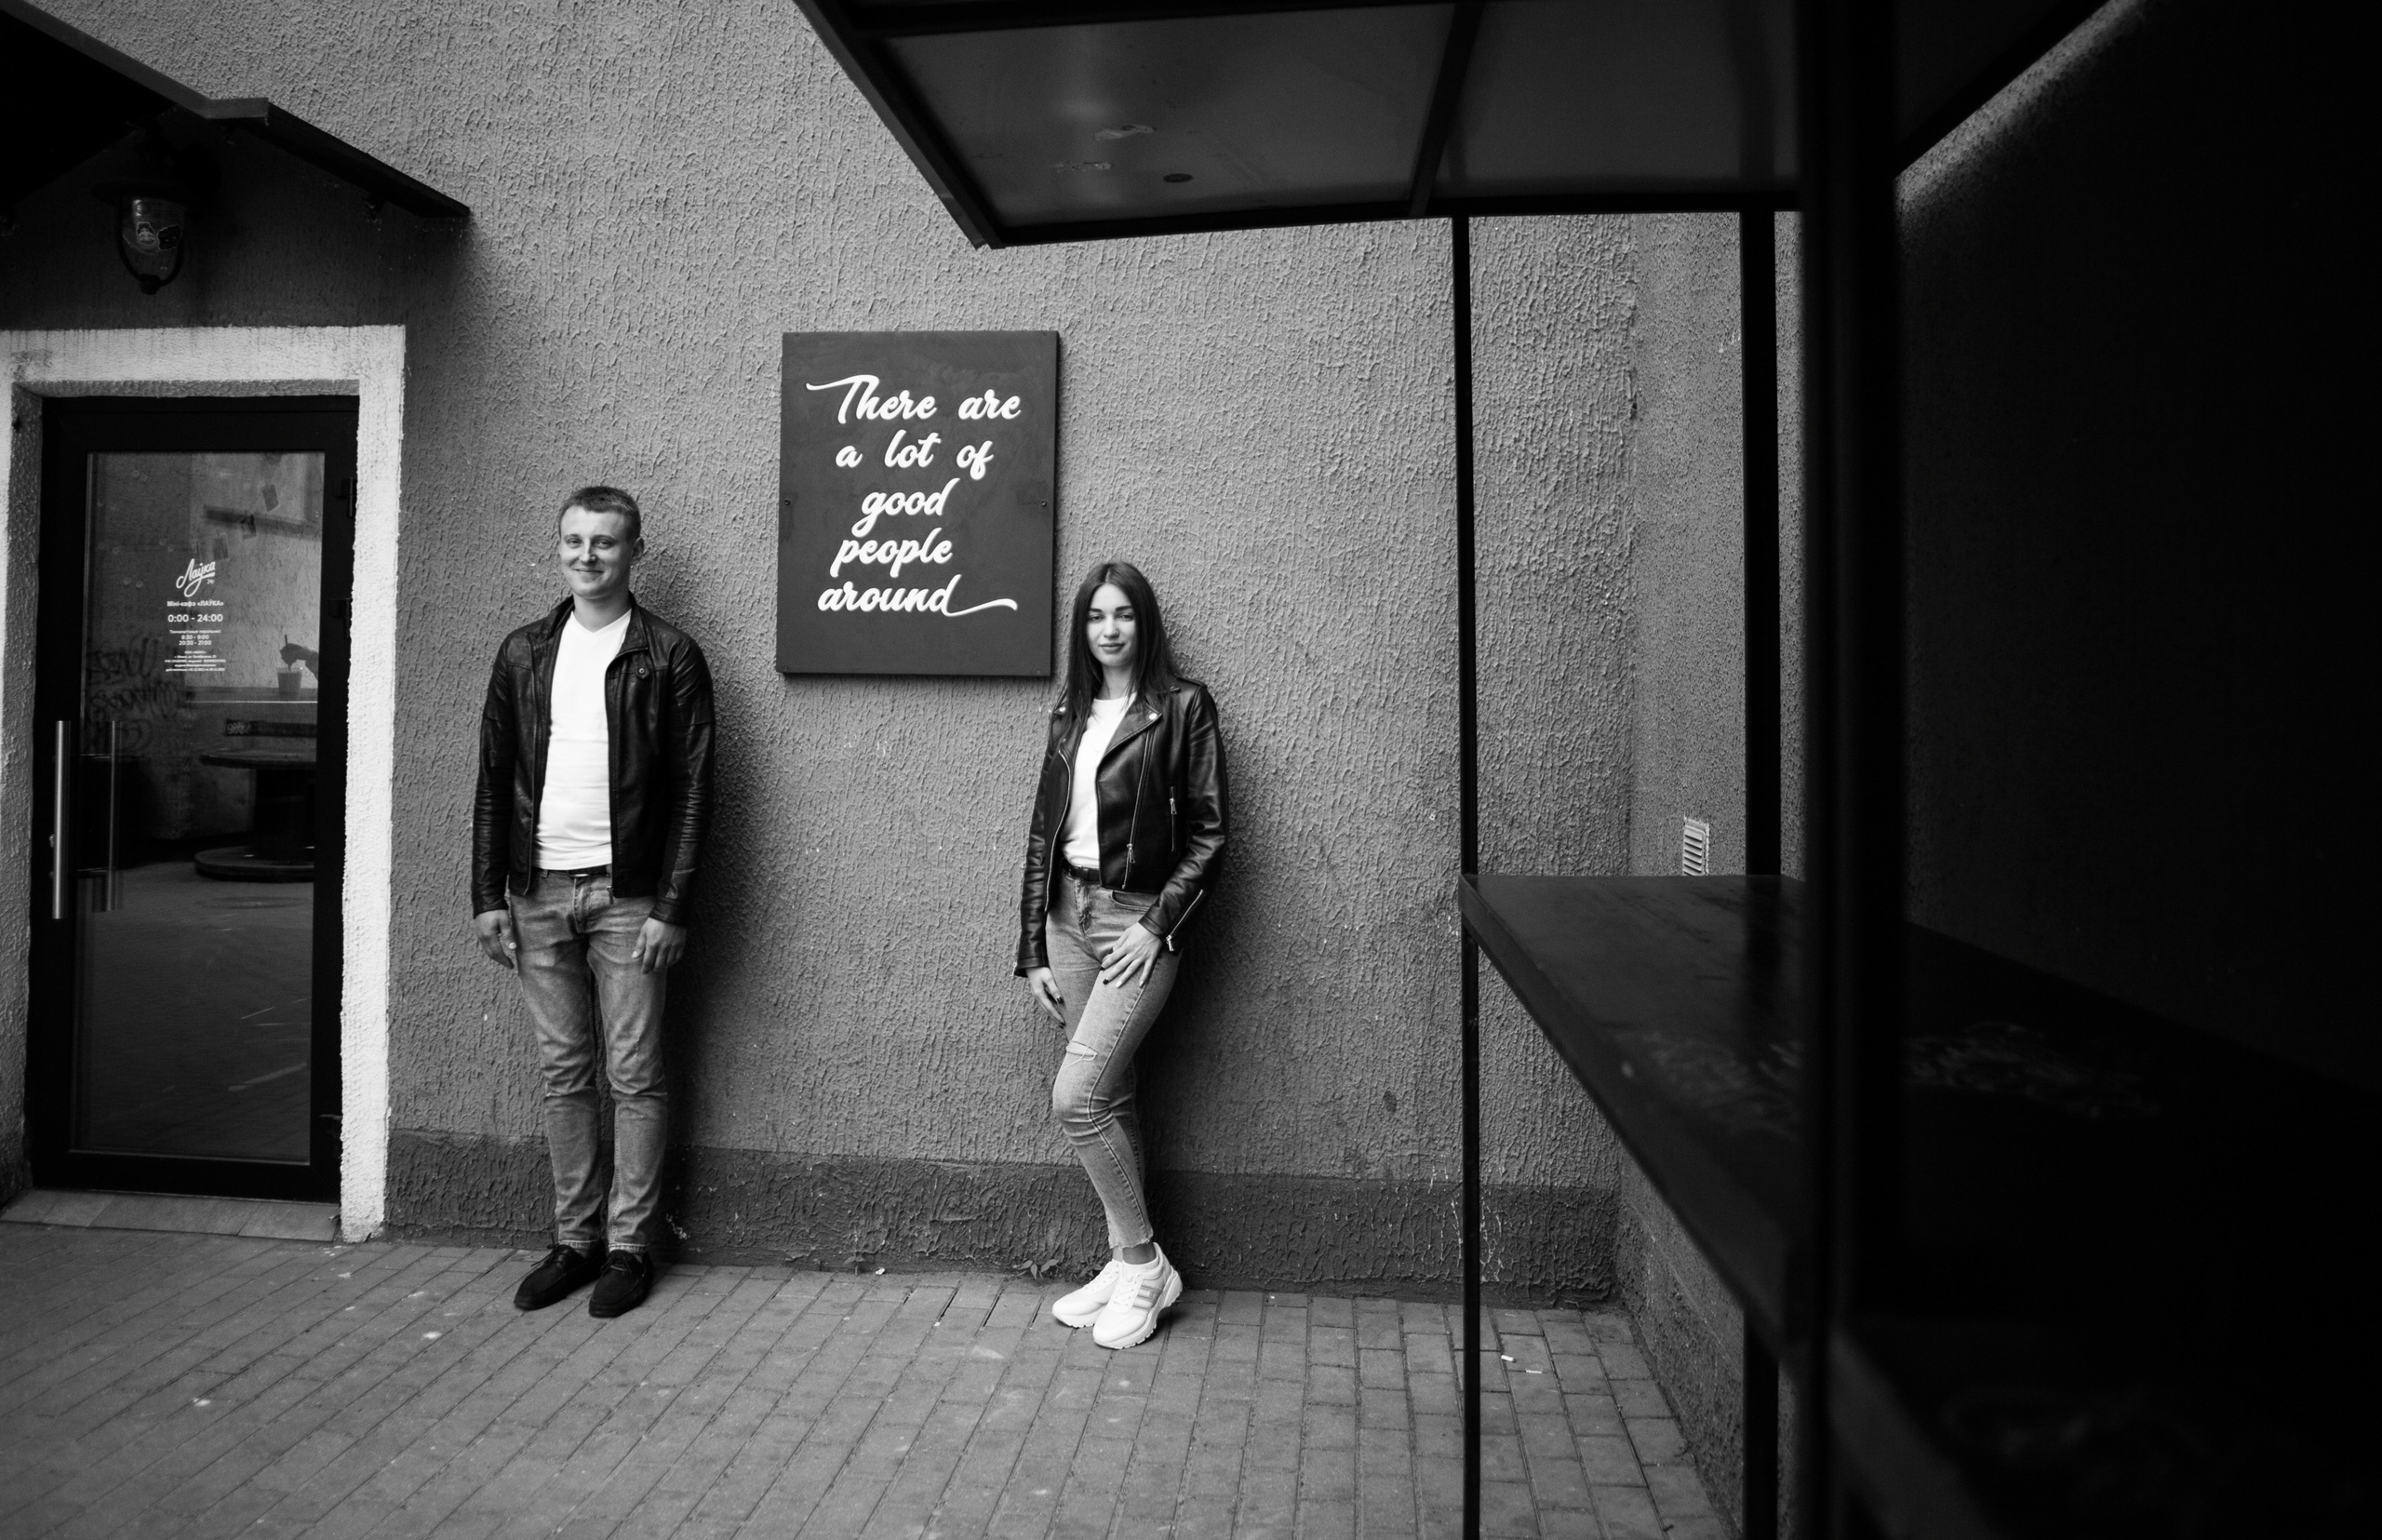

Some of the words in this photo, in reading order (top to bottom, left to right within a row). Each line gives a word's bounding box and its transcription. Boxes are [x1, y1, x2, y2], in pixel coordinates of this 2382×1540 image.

[806, 374, 937, 424] There
[957, 389, 1021, 420] are
[836, 445, 863, 468] a
[884, 429, 942, 468] lot
[957, 440, 994, 480] of
[851, 477, 960, 538] good
[829, 527, 953, 578] people
[167, 614, 189, 623] 0:00
[196, 614, 223, 623] 24:00
[818, 574, 1018, 617] around
